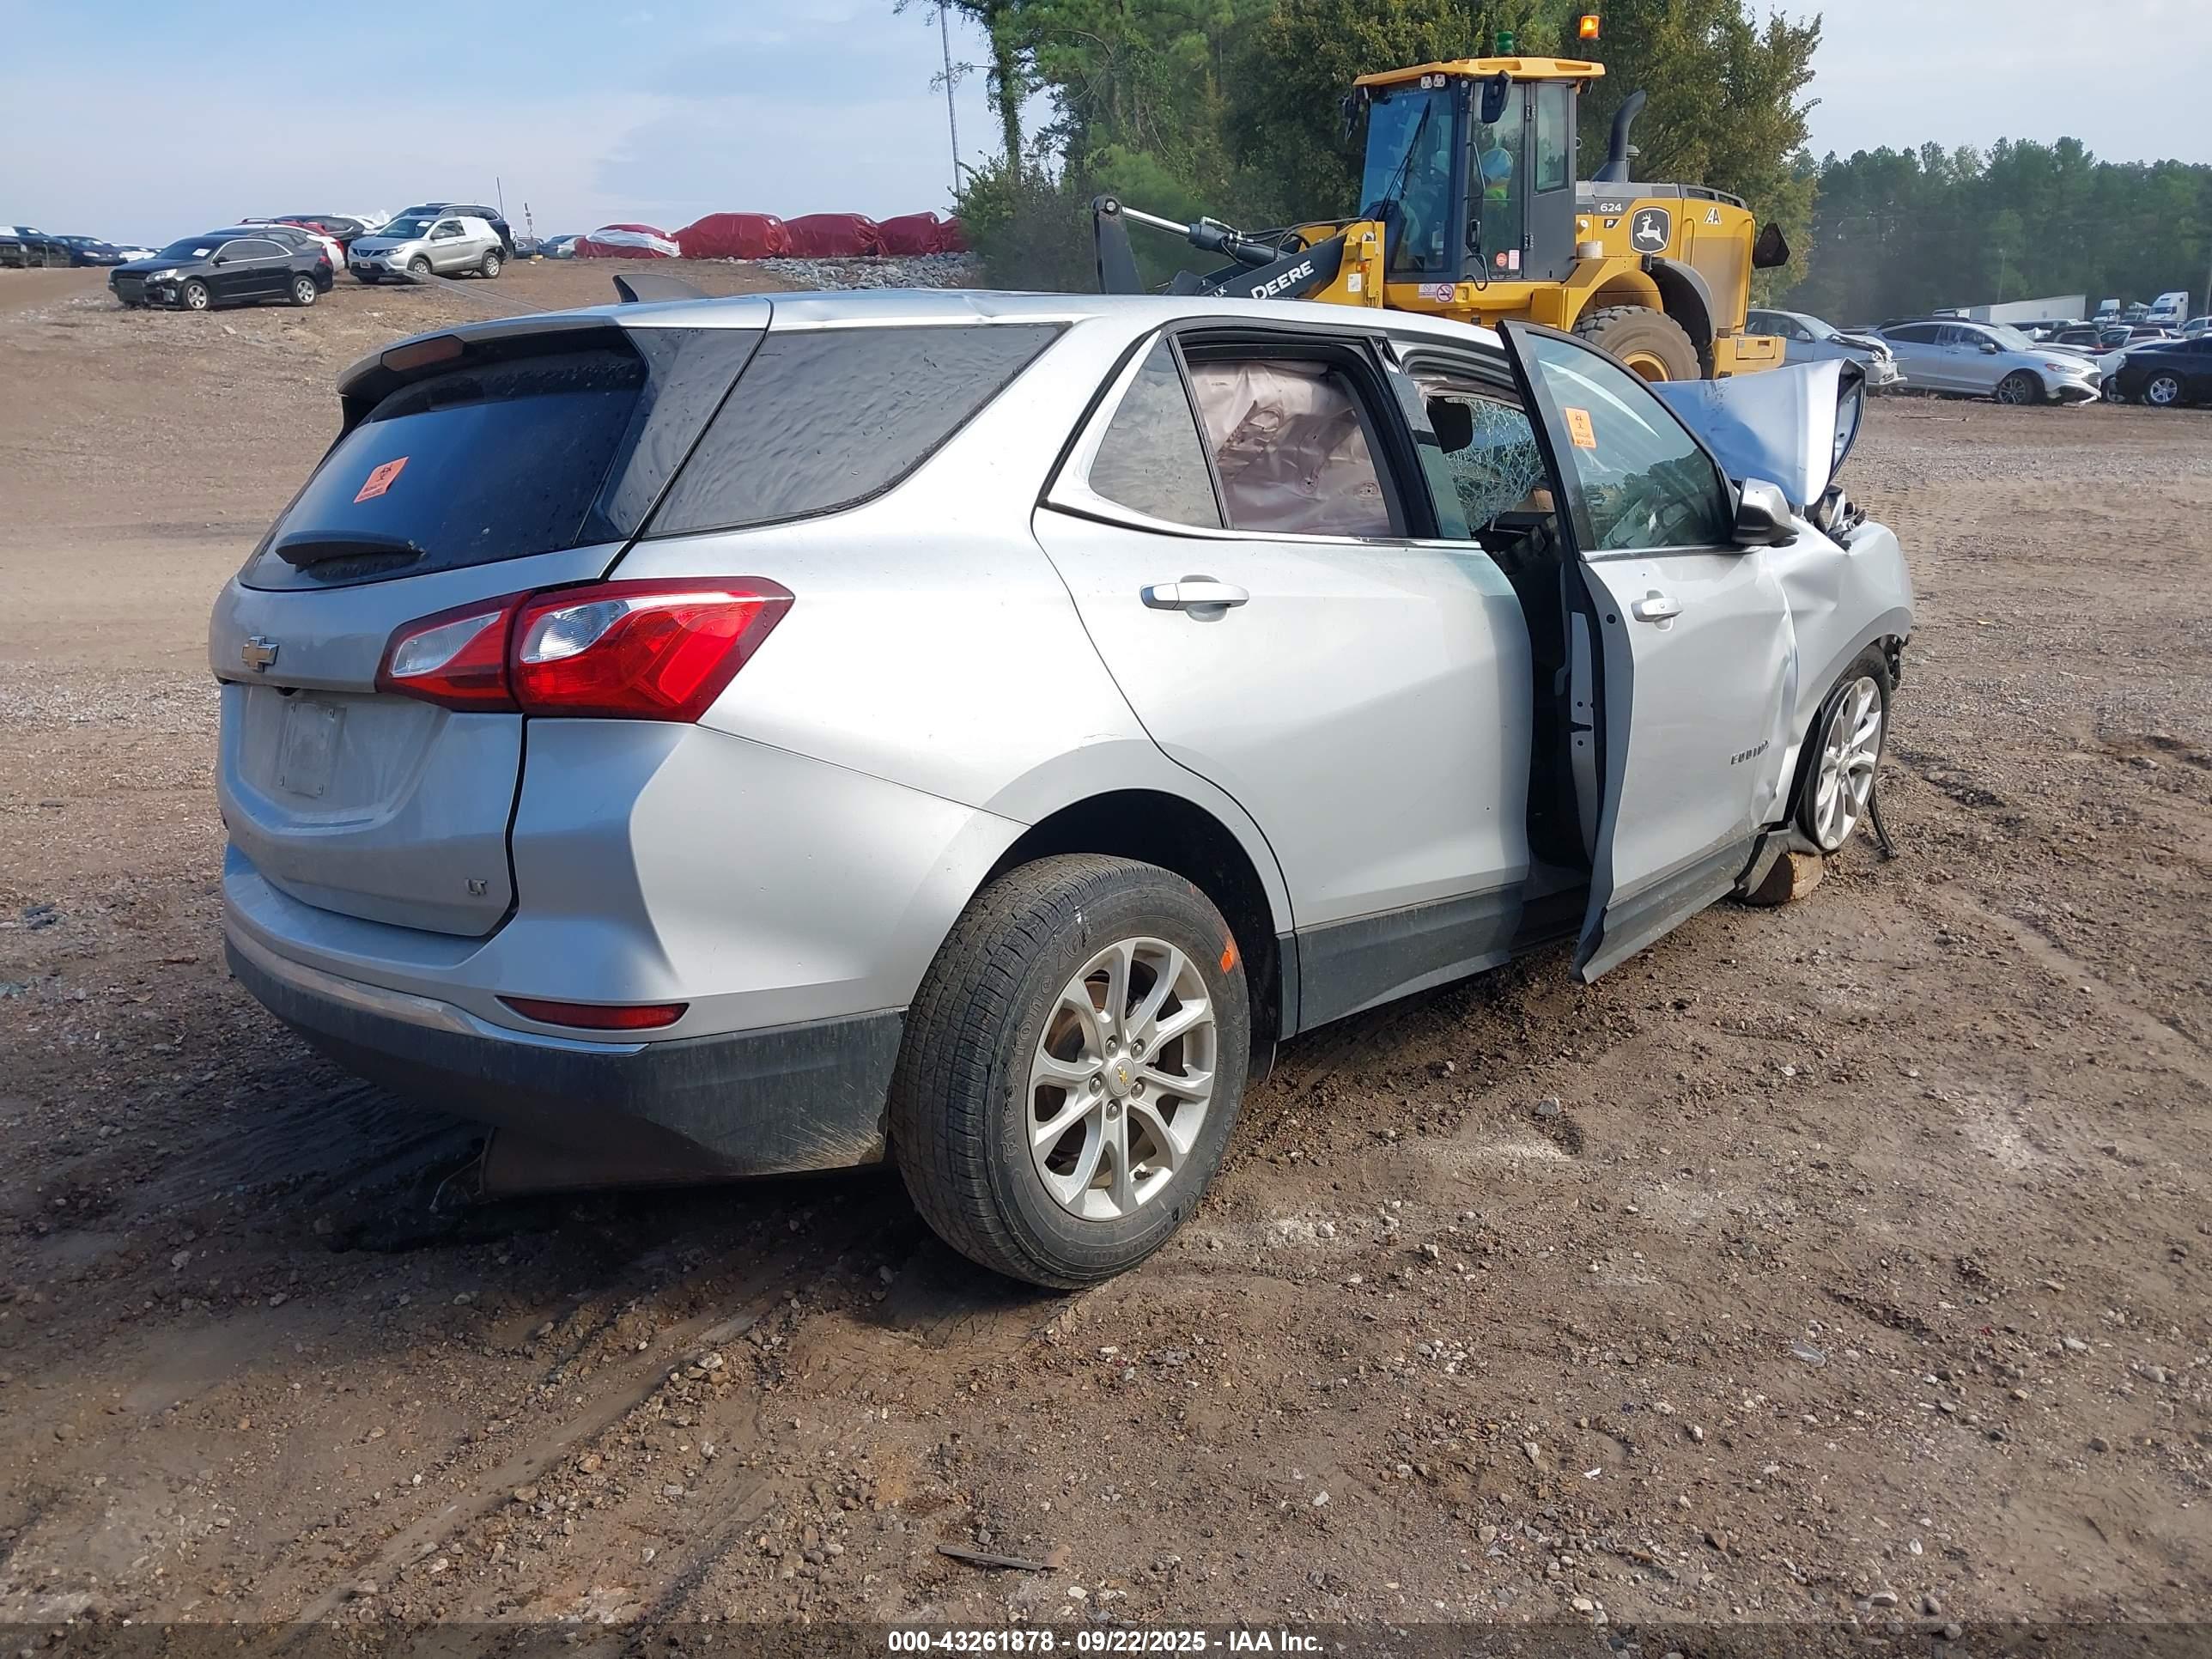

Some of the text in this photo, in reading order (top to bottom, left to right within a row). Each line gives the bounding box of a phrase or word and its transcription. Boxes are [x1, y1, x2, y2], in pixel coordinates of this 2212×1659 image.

[1600, 203, 1622, 212] 624
[1250, 259, 1315, 300] DEERE
[464, 878, 488, 896] LT
[1001, 975, 1054, 1164] Firestone
